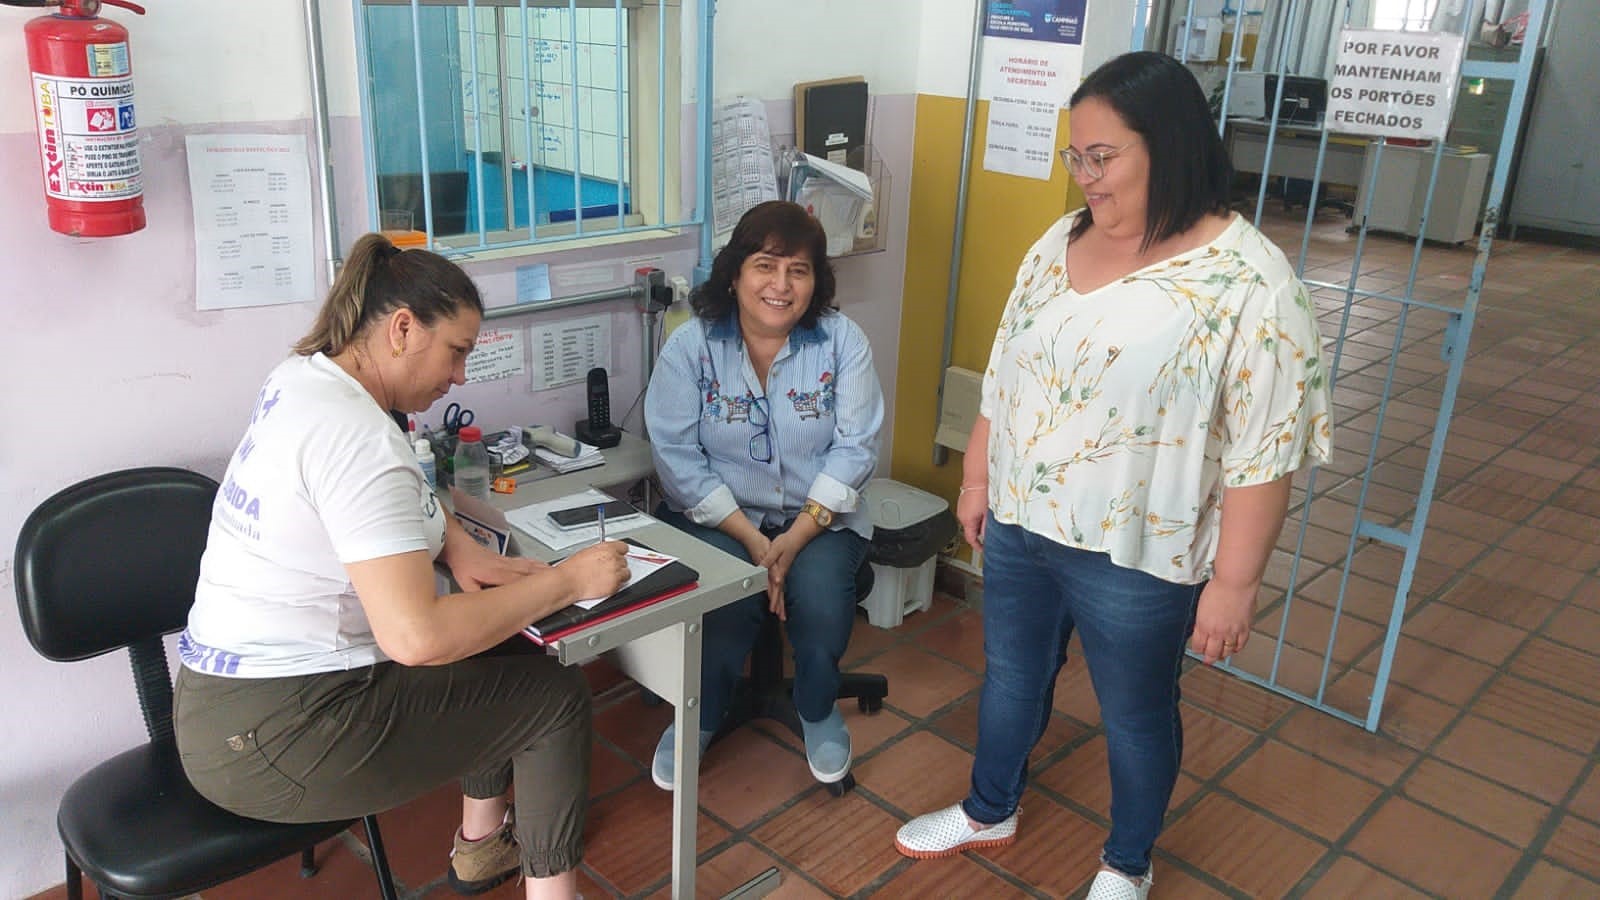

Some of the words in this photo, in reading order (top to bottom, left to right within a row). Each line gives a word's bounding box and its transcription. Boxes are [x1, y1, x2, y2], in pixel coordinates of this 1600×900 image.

[1343, 41, 1378, 56] POR
[1381, 44, 1441, 60] FAVOR
[1008, 56, 1039, 66] HORÁRIO
[1000, 66, 1046, 78] ATENDIMENTO
[1333, 64, 1443, 84] MANTENHAM
[1007, 77, 1048, 87] SECRETARIA
[70, 84, 87, 97] PÓ
[91, 83, 131, 97] QUÍMICO
[1330, 87, 1354, 101] OS
[1334, 110, 1425, 130] FECHADOS
